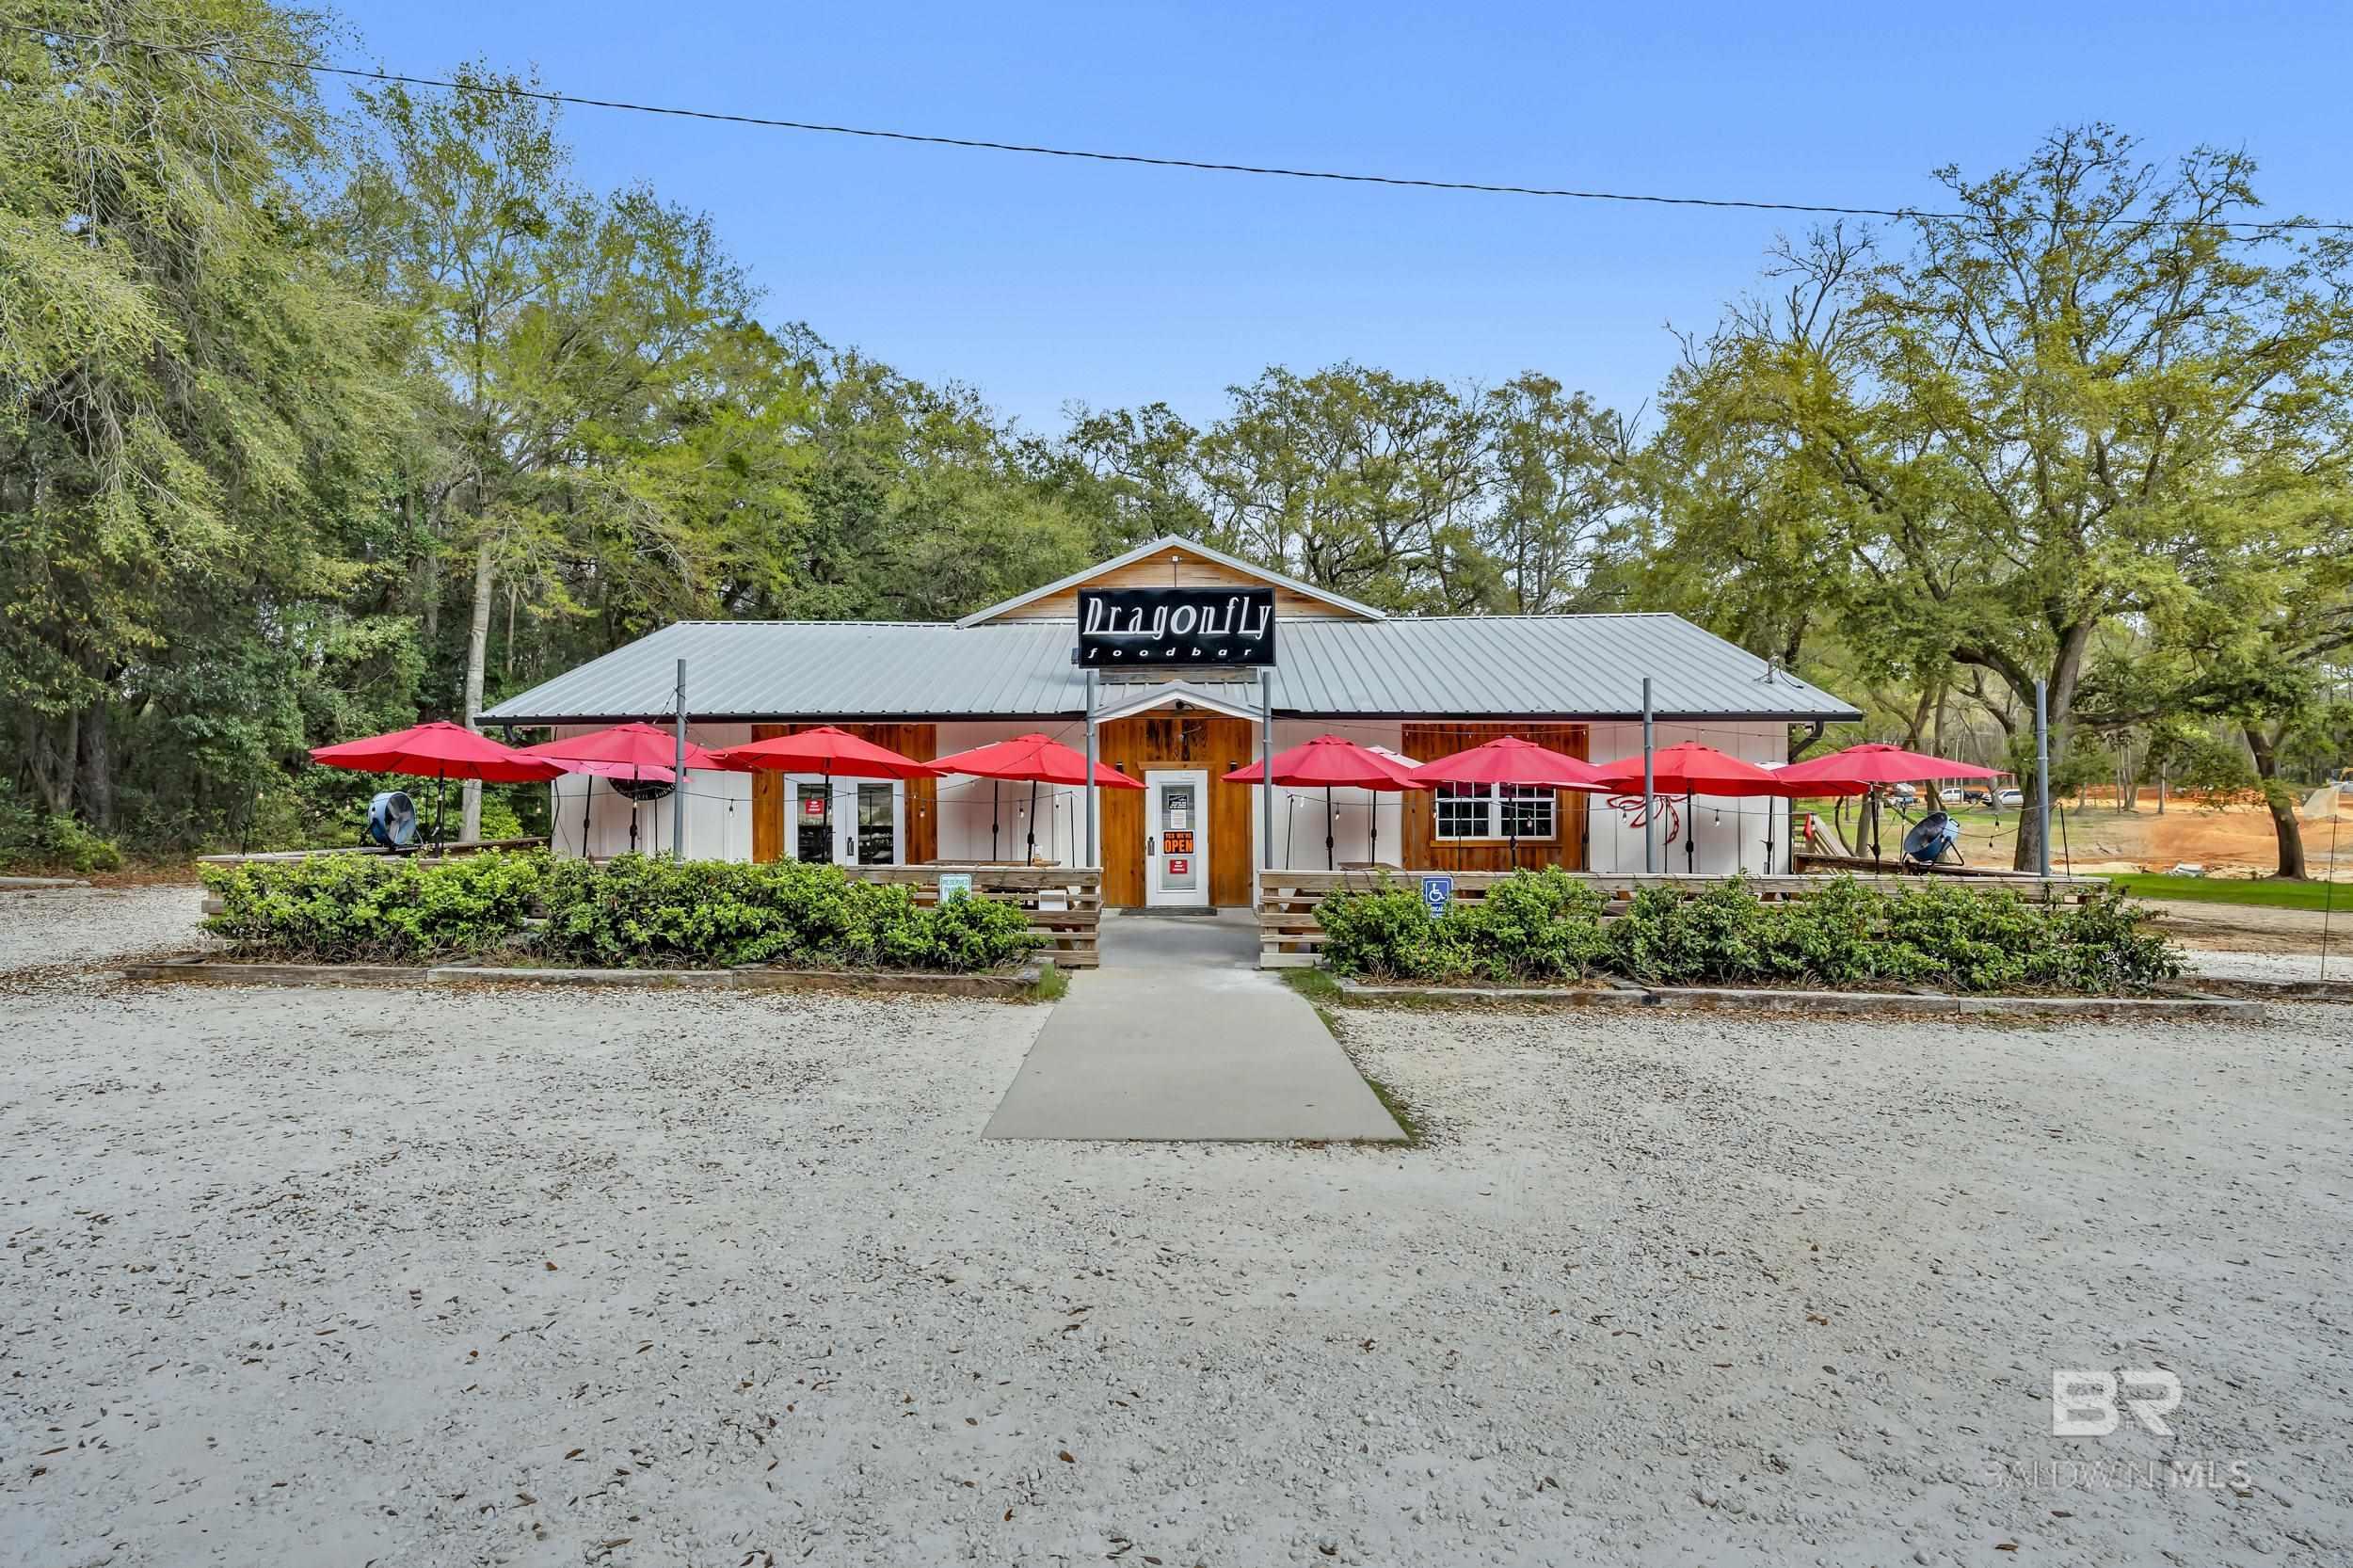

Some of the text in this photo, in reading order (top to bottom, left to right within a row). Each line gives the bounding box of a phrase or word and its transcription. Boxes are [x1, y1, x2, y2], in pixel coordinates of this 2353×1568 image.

[1082, 597, 1273, 640] Dragonfly
[1088, 647, 1252, 659] foodbar
[1164, 840, 1193, 853] OPEN
